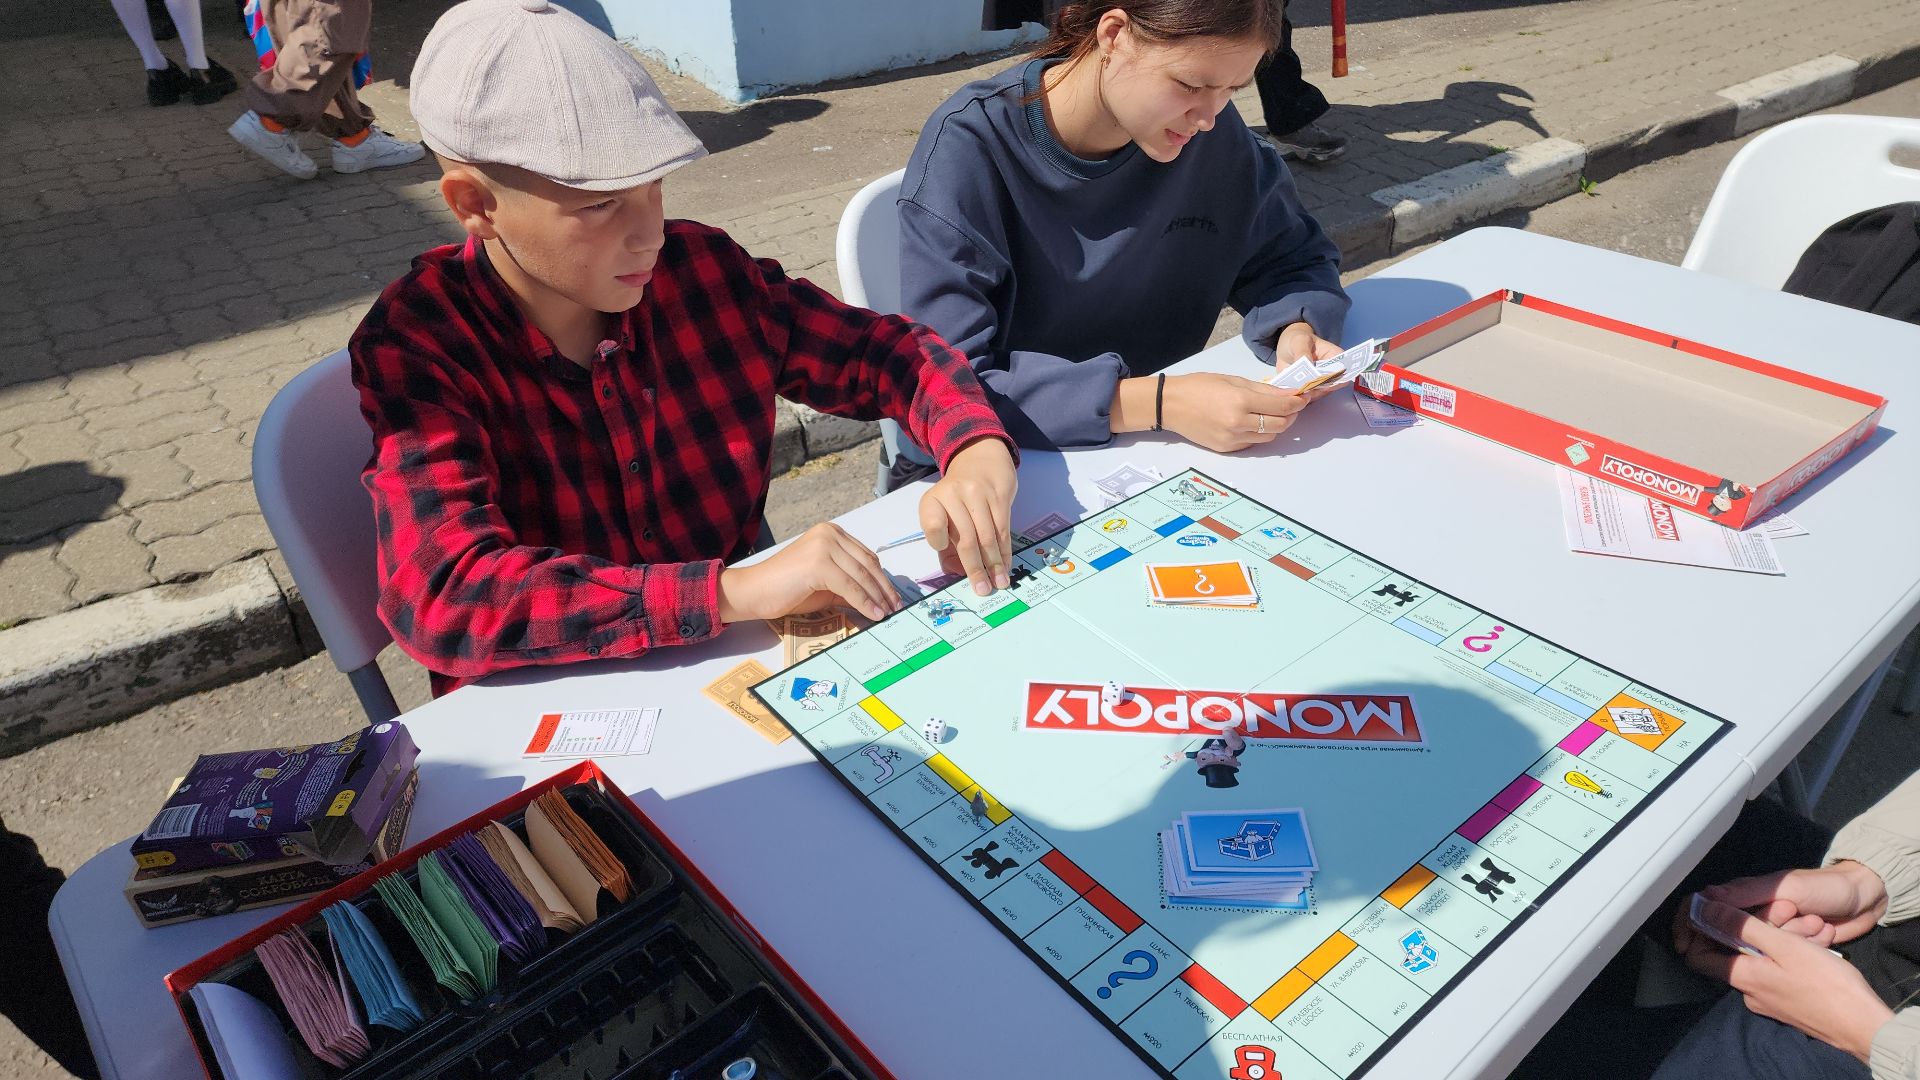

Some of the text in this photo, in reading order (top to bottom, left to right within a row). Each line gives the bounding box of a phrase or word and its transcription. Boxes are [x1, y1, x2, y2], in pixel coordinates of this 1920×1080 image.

[1603, 459, 1697, 500] MONOPOLY
[1032, 688, 1404, 737] MONOPOLY
[1630, 687, 1689, 716] ЭКСКУРСИИ
[1676, 740, 1692, 750] НА
[255, 869, 306, 888] КАРТА
[1073, 905, 1116, 941] ПУШКИНСКАЯ
[1349, 903, 1390, 938] ОБЩЕСТВЕННАЯ
[1367, 916, 1386, 934] КАЗНА
[1149, 941, 1171, 960] ШАНС
[1338, 955, 1370, 982] ВАВИЛОВА
[1172, 987, 1216, 1024] УЛ. ТВЕРСКАЯ
[1300, 1006, 1325, 1028] ШОССЕ
[1222, 1032, 1283, 1043] БЕСПЛАТНАЯ
